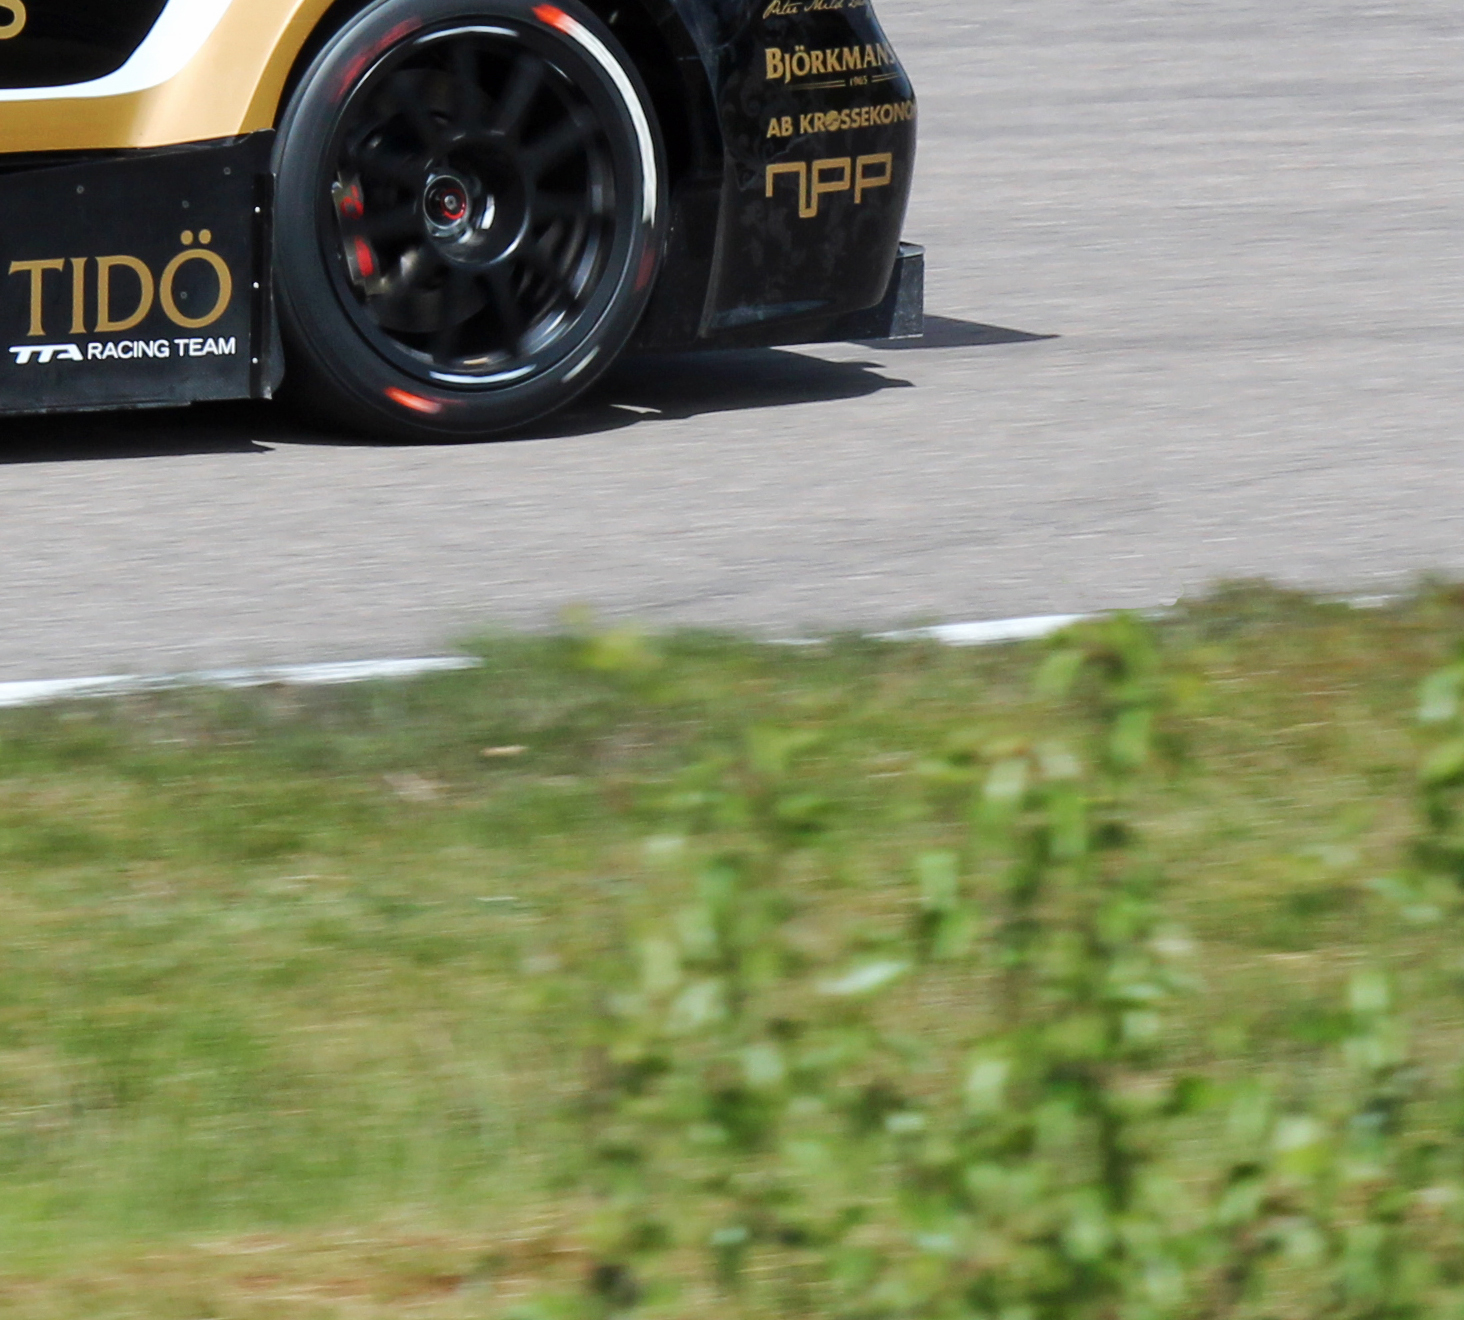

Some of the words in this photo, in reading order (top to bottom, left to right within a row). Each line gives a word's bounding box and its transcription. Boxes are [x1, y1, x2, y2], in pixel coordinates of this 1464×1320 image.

[766, 117, 794, 138] AB
[8, 229, 233, 337] TIDÖ
[8, 343, 84, 364] TTA
[87, 339, 170, 361] RACING
[174, 337, 237, 357] TEAM
